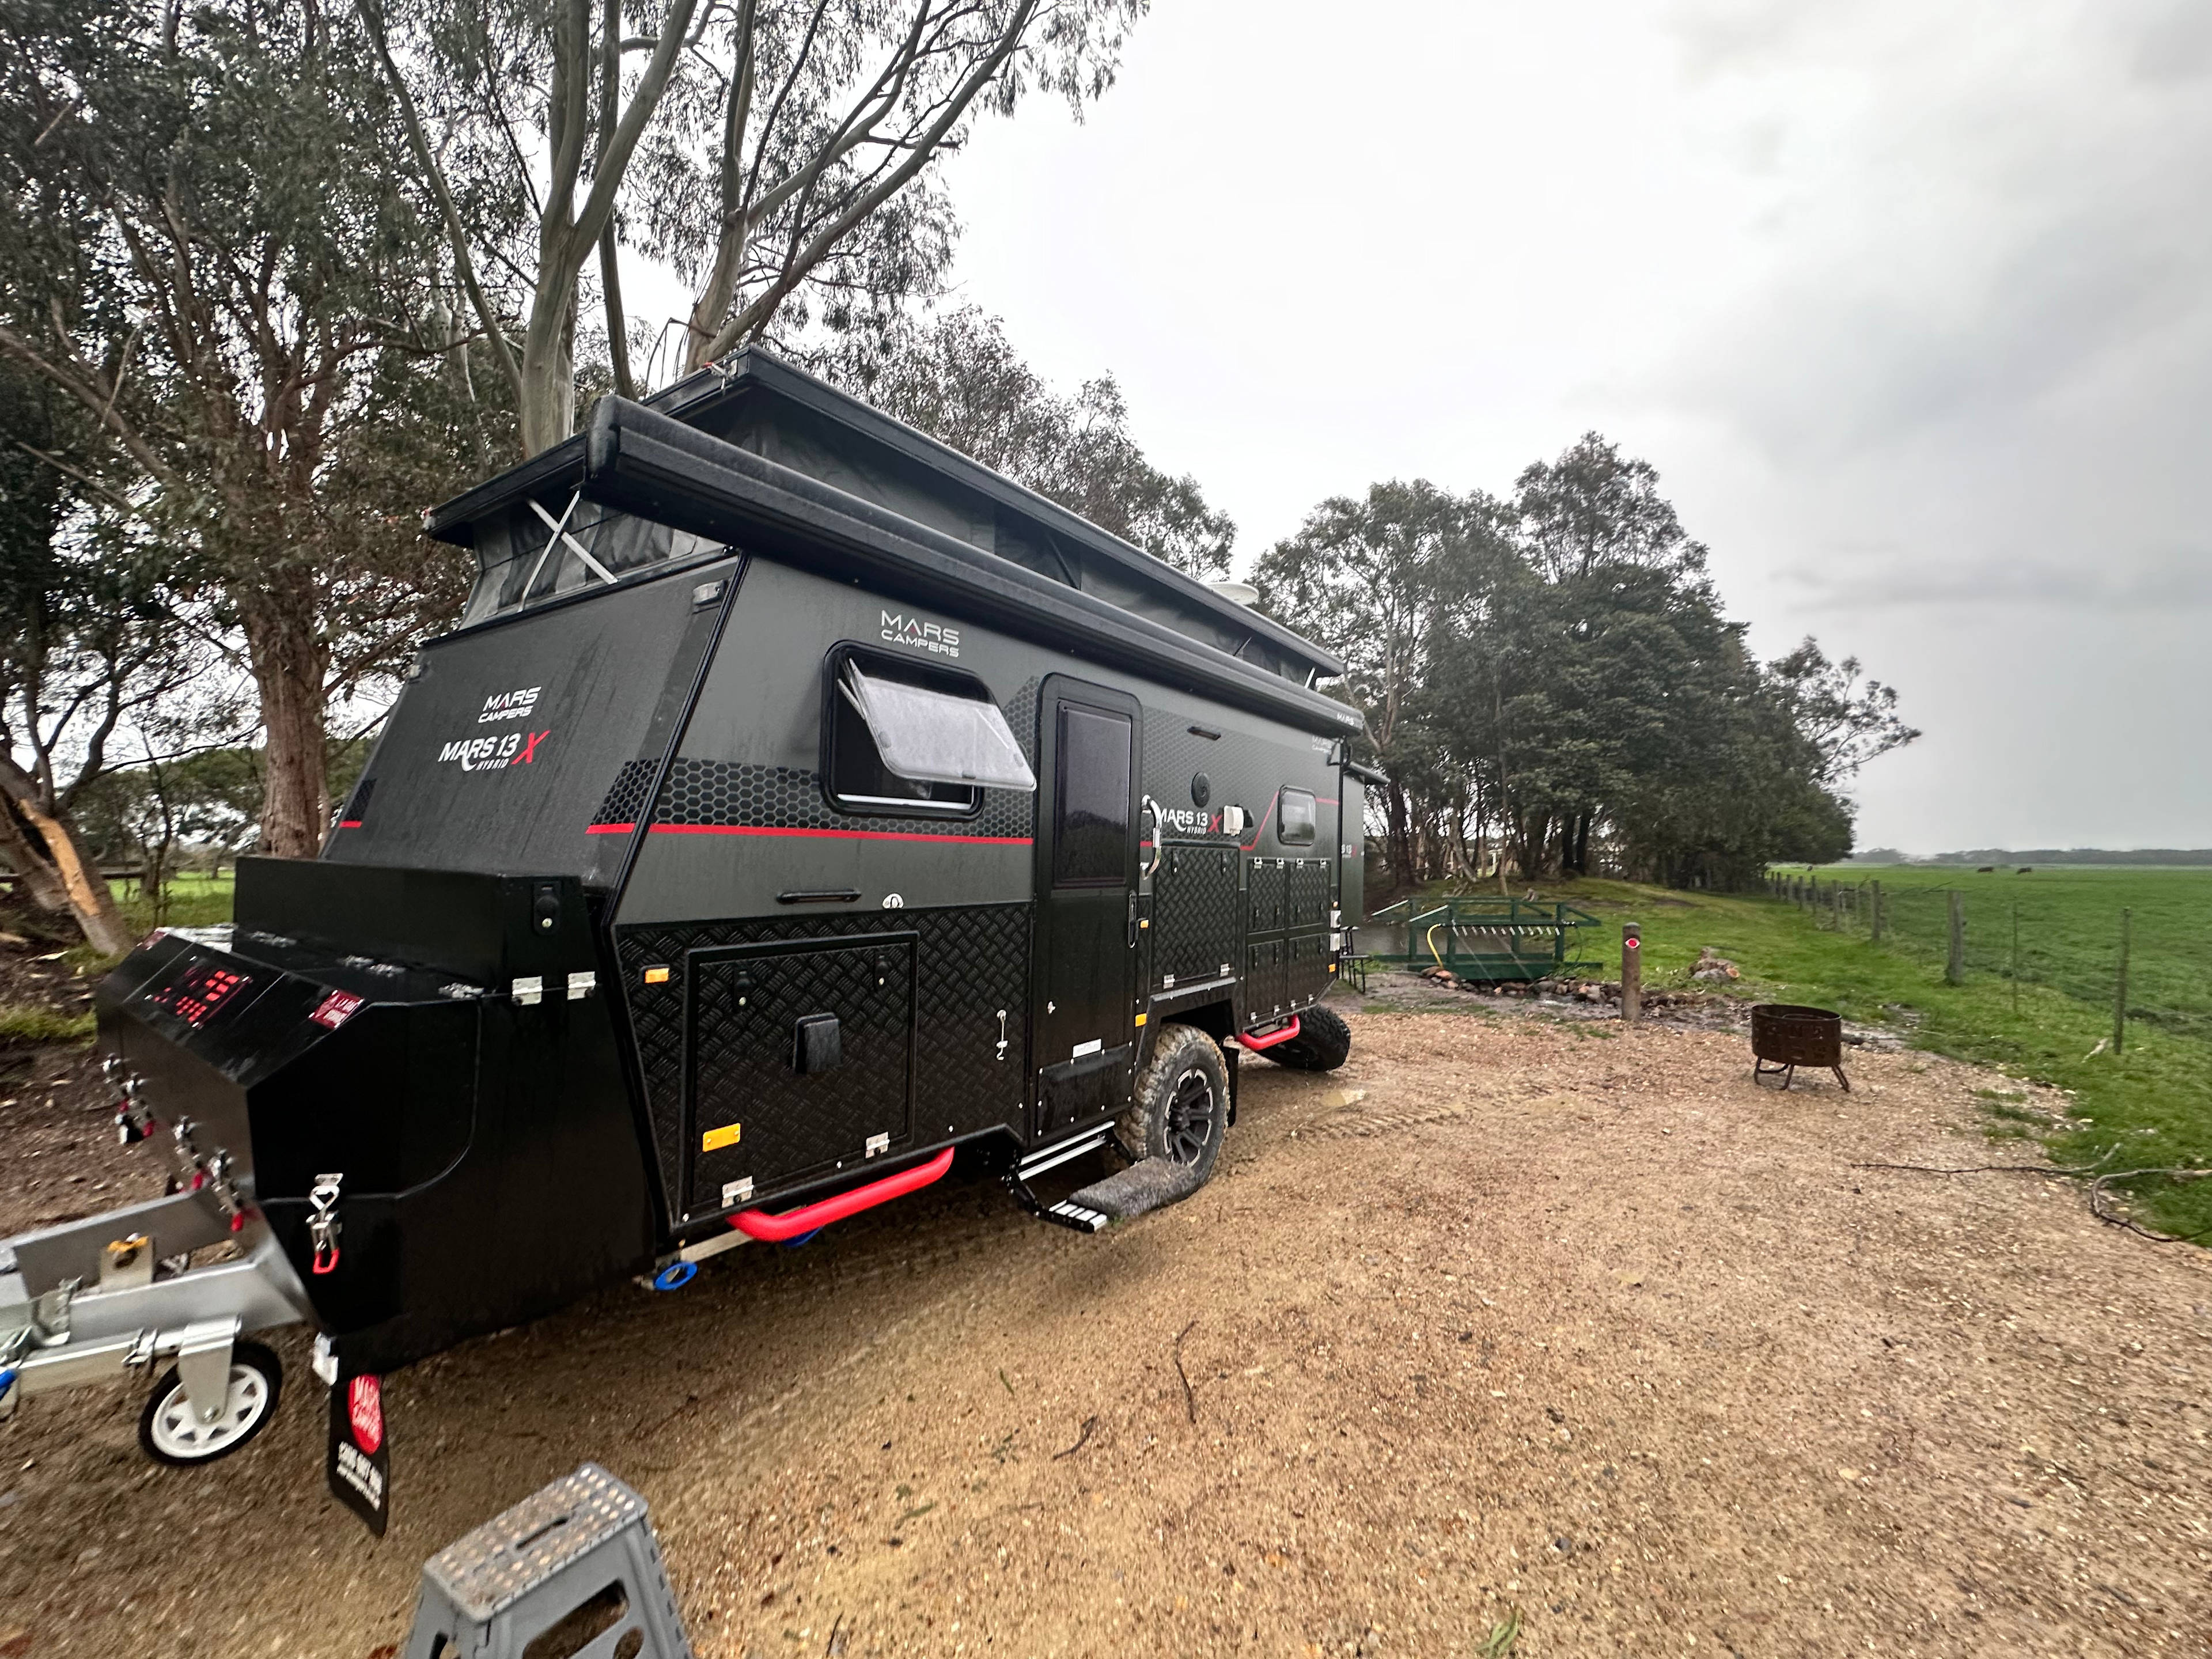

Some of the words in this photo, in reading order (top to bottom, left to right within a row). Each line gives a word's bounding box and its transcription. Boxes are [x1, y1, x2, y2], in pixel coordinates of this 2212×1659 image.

[881, 609, 959, 646] MARS
[881, 629, 959, 658] CAMPERS
[483, 686, 542, 712] MARS
[478, 706, 534, 724] CAMPERS
[438, 736, 498, 772] MARS
[496, 733, 521, 757] 13
[475, 757, 509, 771] HYBRID
[1187, 825, 1207, 835] HYBRID
[1196, 812, 1209, 827] 13
